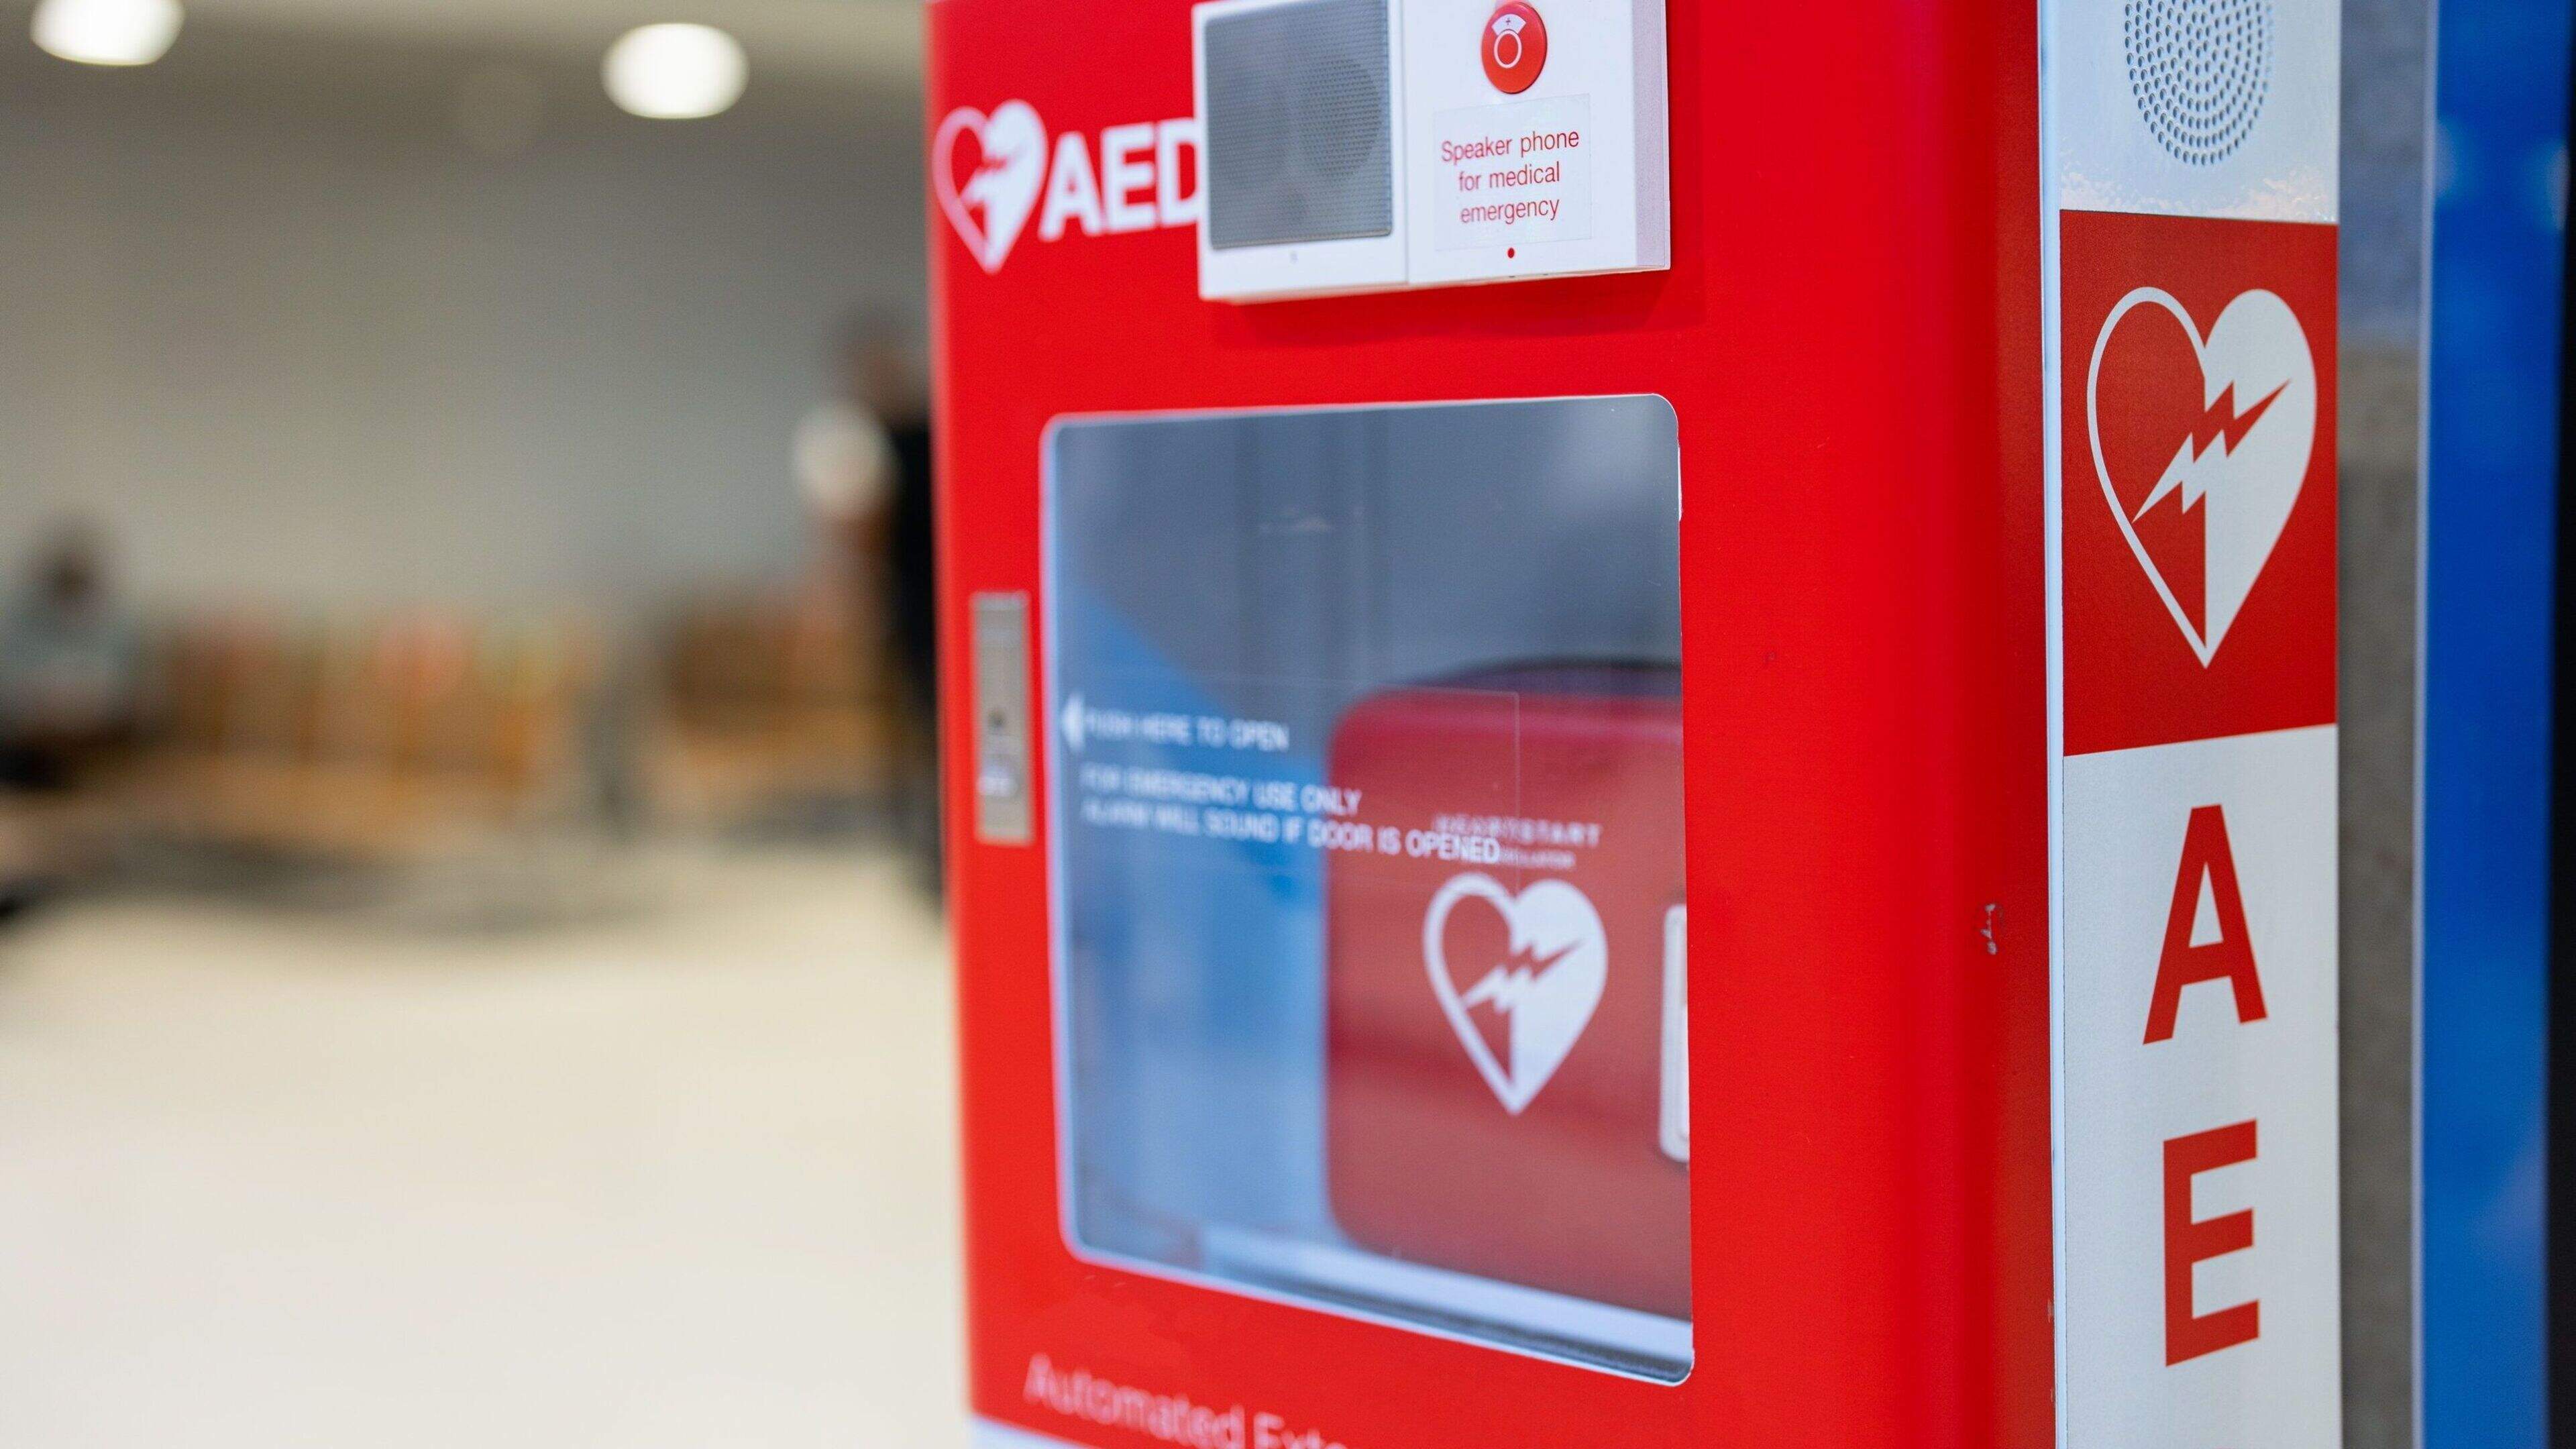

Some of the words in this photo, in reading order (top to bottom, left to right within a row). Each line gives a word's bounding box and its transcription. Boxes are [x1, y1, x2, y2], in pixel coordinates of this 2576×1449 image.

[1442, 136, 1513, 165] Speaker
[1521, 130, 1580, 158] phone
[1040, 117, 1197, 240] AED
[1459, 170, 1481, 191] for
[1489, 160, 1560, 188] medical
[1460, 199, 1560, 225] emergency
[1141, 713, 1191, 745] HERE
[1197, 717, 1226, 747] TO
[1229, 718, 1289, 751] OPEN
[1126, 767, 1248, 805] EMERGENCY
[1252, 781, 1297, 812] USE
[1300, 784, 1362, 816] ONLY
[1203, 807, 1280, 843] SOUND
[1282, 815, 1303, 844] IF
[1307, 818, 1373, 852] DOOR
[1377, 826, 1401, 855] IS
[1405, 829, 1501, 865] OPENED
[1024, 1352, 1246, 1449] Automated
